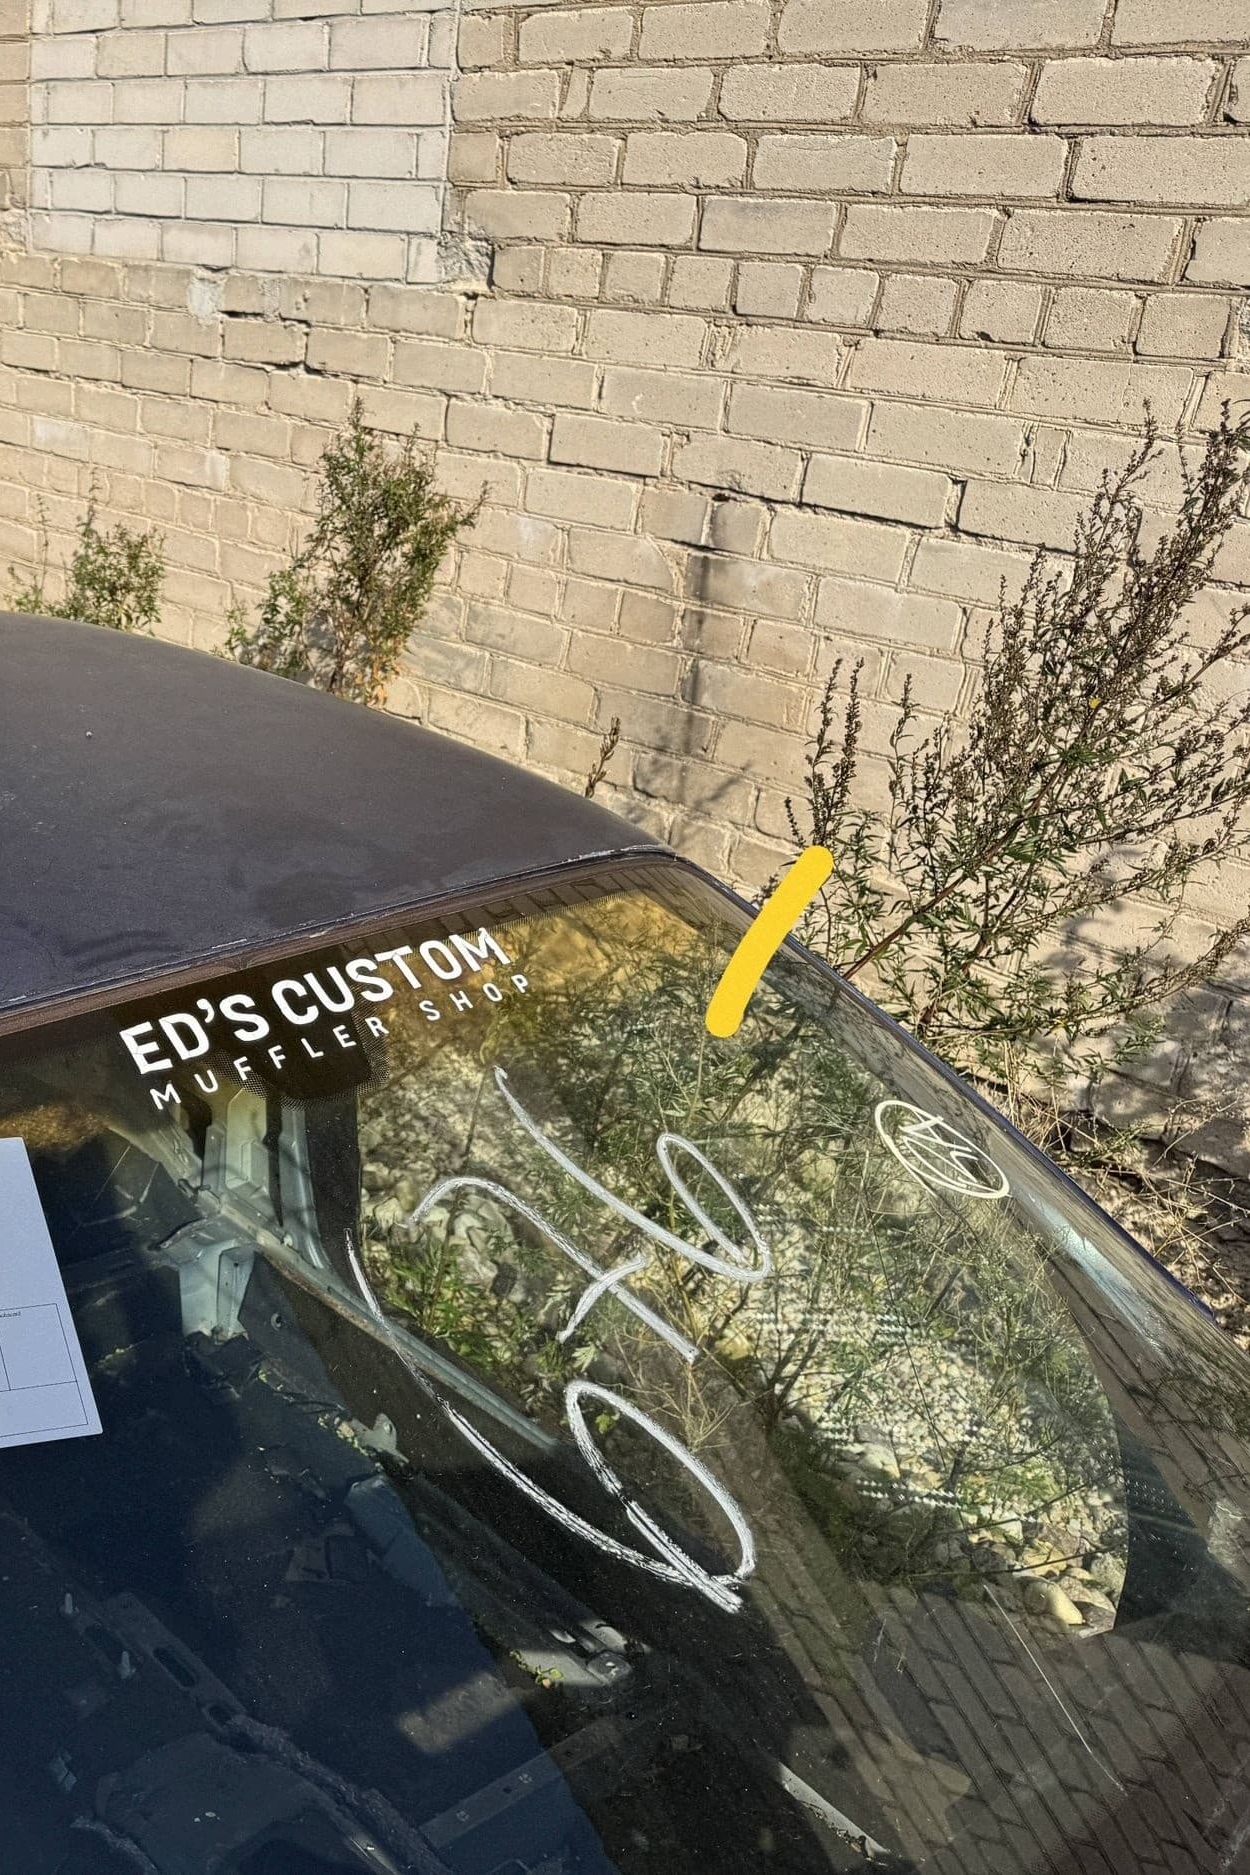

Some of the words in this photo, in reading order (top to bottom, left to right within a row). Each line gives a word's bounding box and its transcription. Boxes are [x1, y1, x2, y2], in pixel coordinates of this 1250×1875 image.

[119, 993, 270, 1074] ED'S
[271, 928, 511, 1026] CUSTOM
[149, 1016, 389, 1111] MUFFLER
[419, 973, 530, 1022] SHOP
